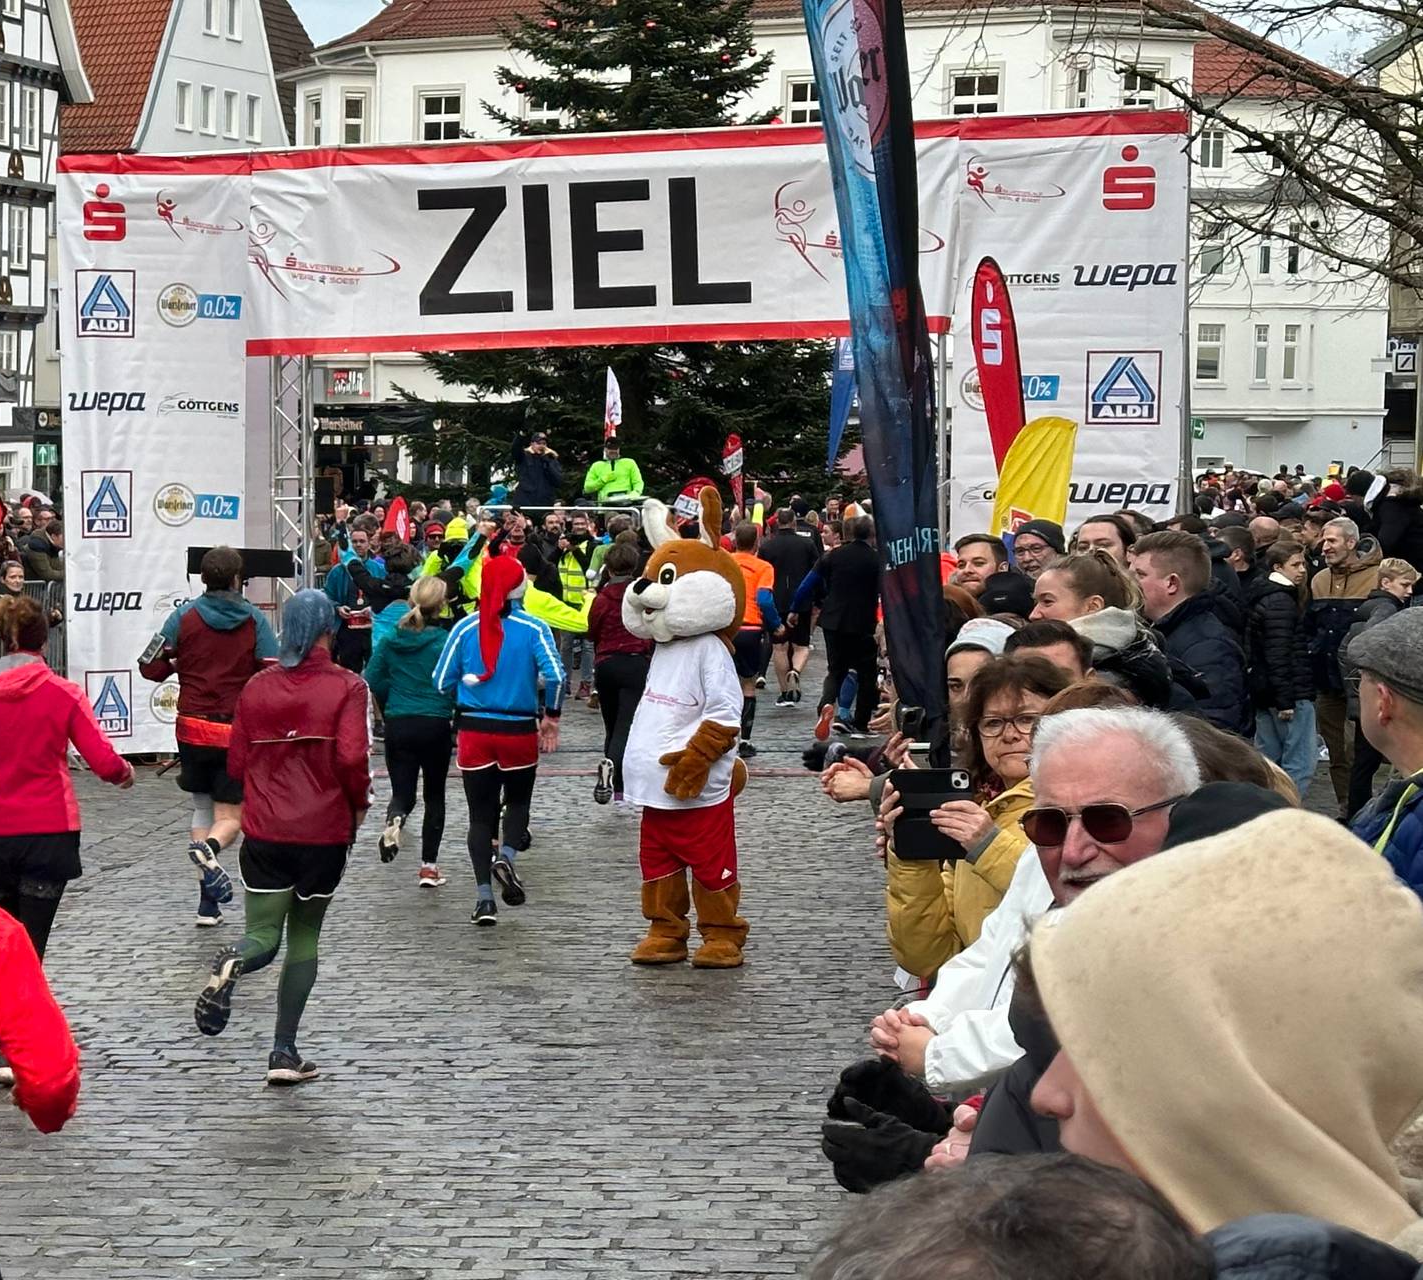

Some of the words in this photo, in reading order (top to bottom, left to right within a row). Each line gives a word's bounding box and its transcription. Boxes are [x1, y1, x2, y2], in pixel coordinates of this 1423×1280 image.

[417, 177, 752, 316] ZIEL
[1003, 273, 1060, 284] TTGENS
[1074, 264, 1177, 291] wepa
[203, 296, 235, 318] 0,0%
[87, 318, 125, 331] ALDI
[1024, 376, 1052, 399] ,0%
[68, 392, 146, 416] wepa
[177, 398, 239, 413] GÖTTGENS
[1098, 404, 1149, 418] ALDI
[1069, 483, 1170, 508] wepa
[201, 497, 233, 517] 0,0%
[91, 519, 123, 531] ALDI
[73, 592, 142, 616] wepa
